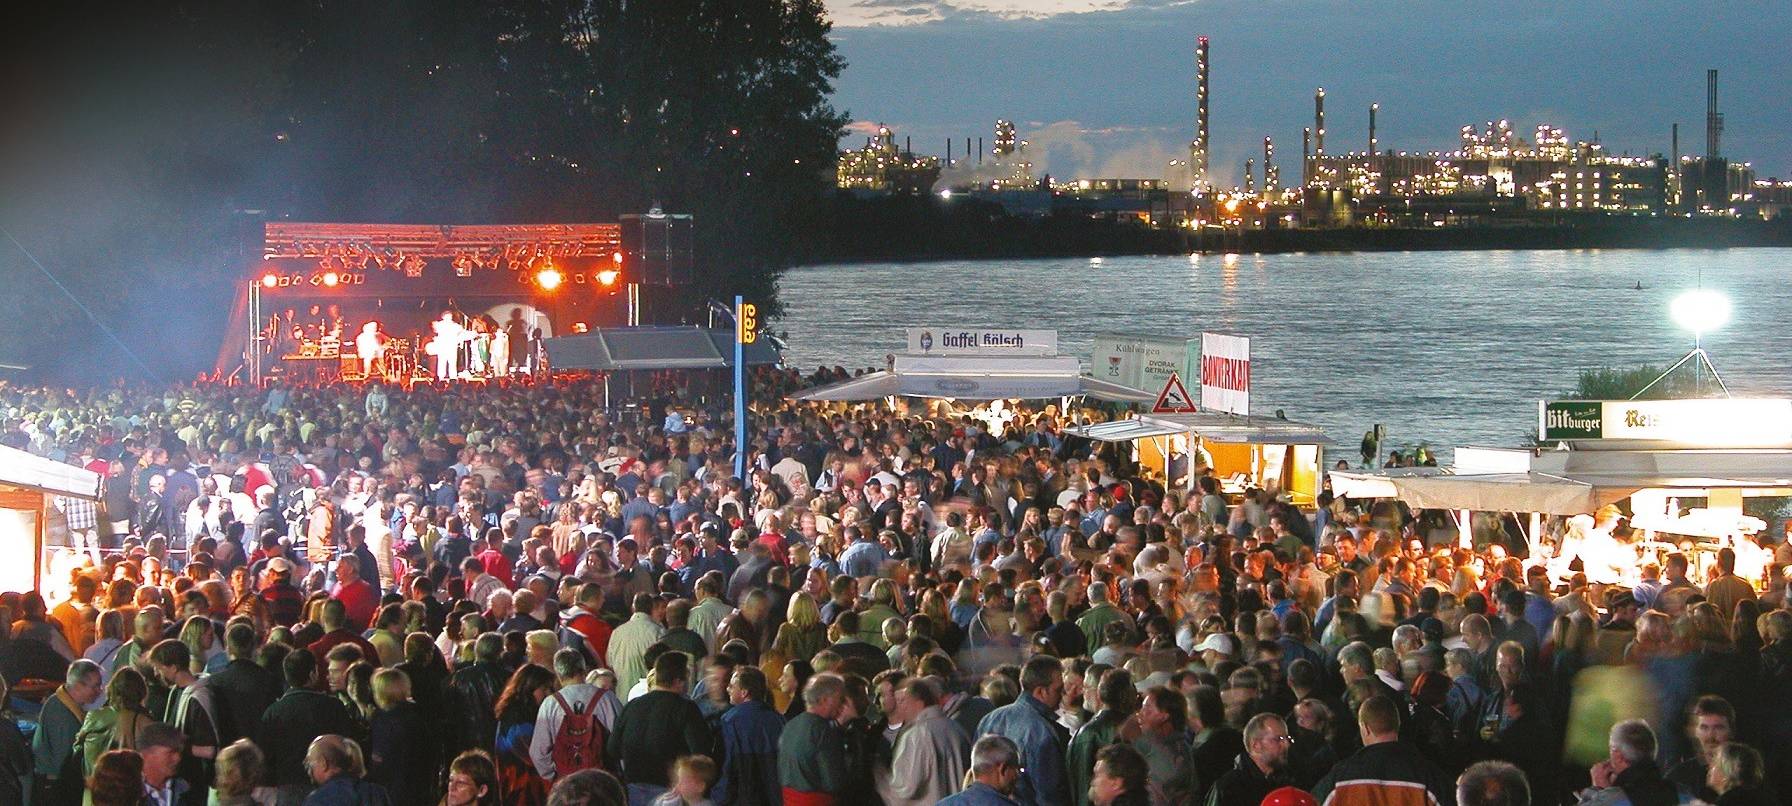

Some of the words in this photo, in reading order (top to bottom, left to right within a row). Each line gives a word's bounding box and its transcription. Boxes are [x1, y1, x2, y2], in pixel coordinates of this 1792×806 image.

[943, 332, 978, 348] Gaffel
[983, 333, 1023, 348] Kölsch
[1546, 409, 1600, 432] Bitburger
